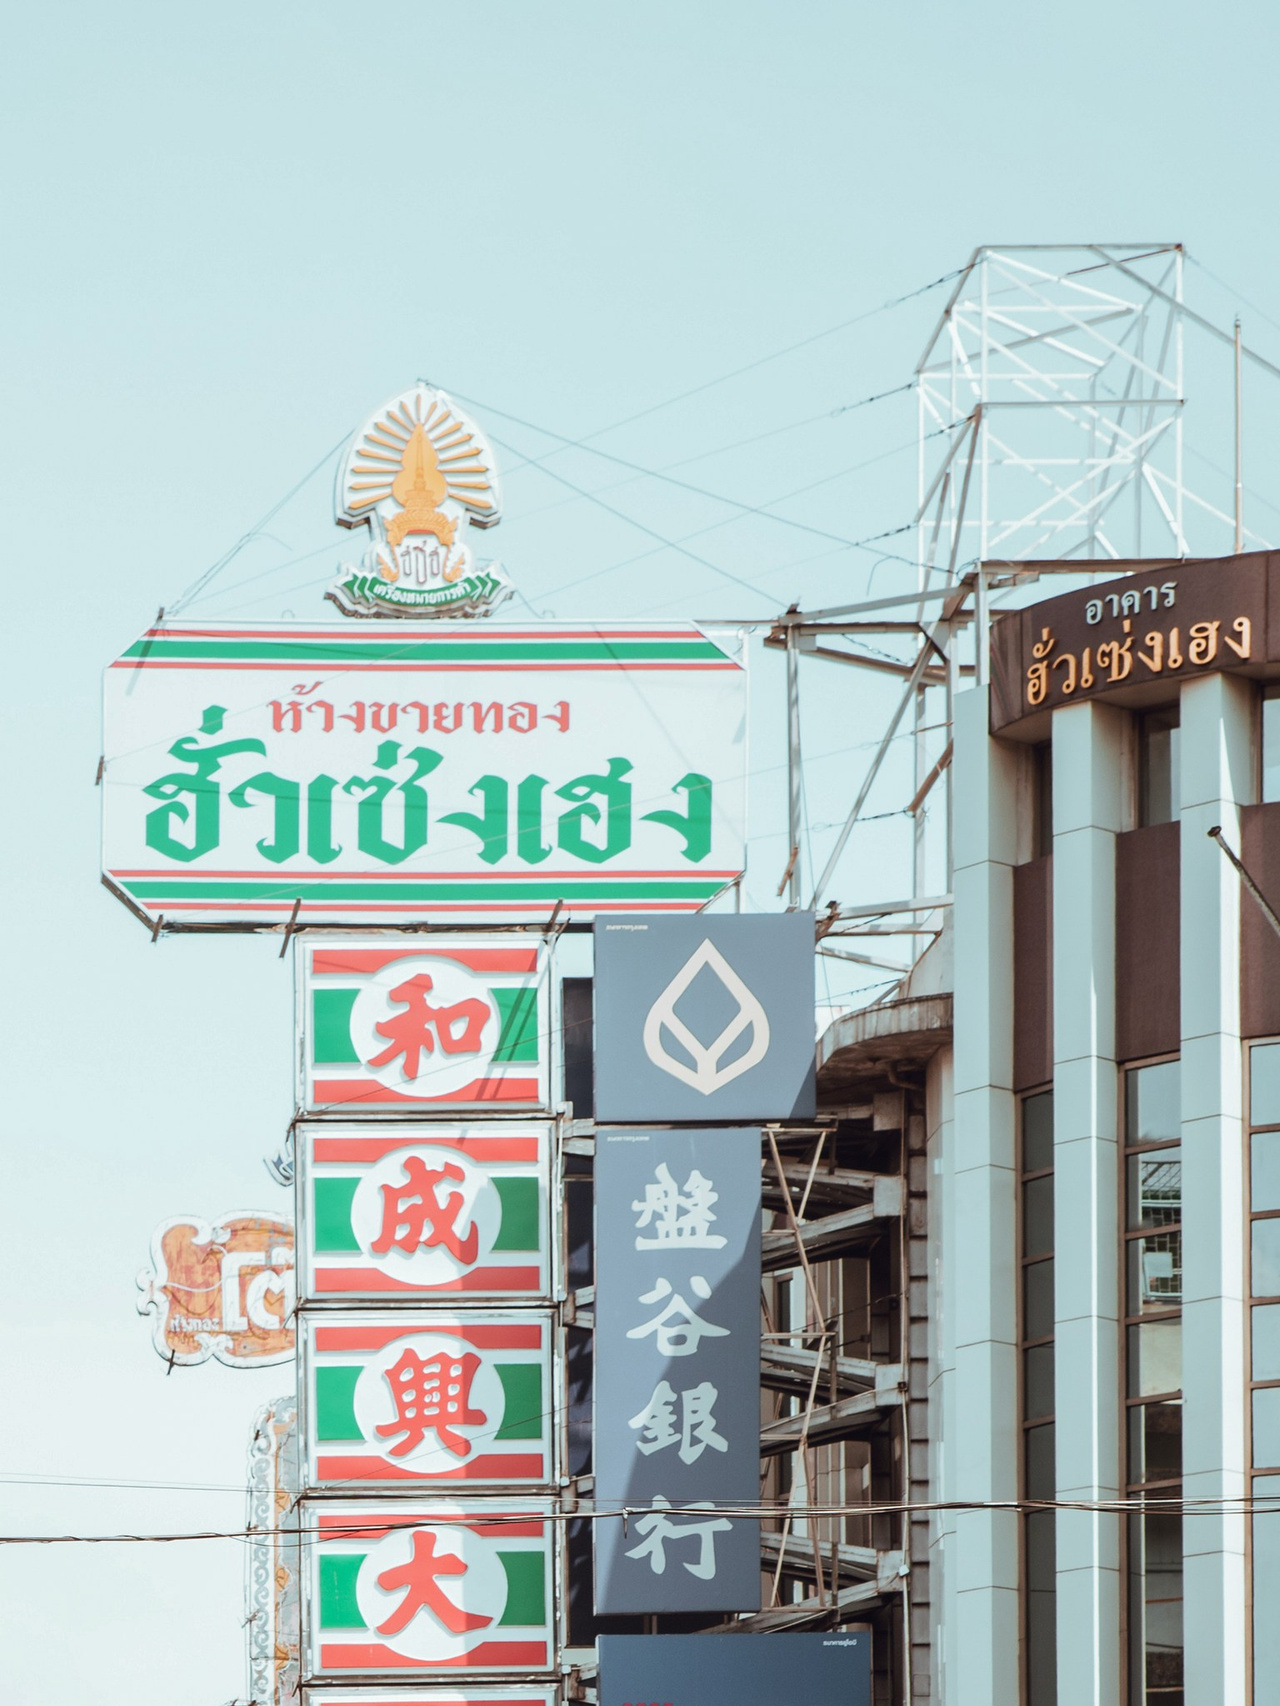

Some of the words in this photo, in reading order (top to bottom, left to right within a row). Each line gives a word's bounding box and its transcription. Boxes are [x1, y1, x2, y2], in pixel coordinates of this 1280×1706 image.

[1085, 581, 1178, 625] อาคาร
[1026, 616, 1251, 705] ฮั่วเซ่งเฮง
[267, 680, 571, 735] ห้างขายทอง
[141, 704, 713, 864] ฮั่วเซ่งเฮง
[625, 1162, 732, 1580] 盤谷銀行
